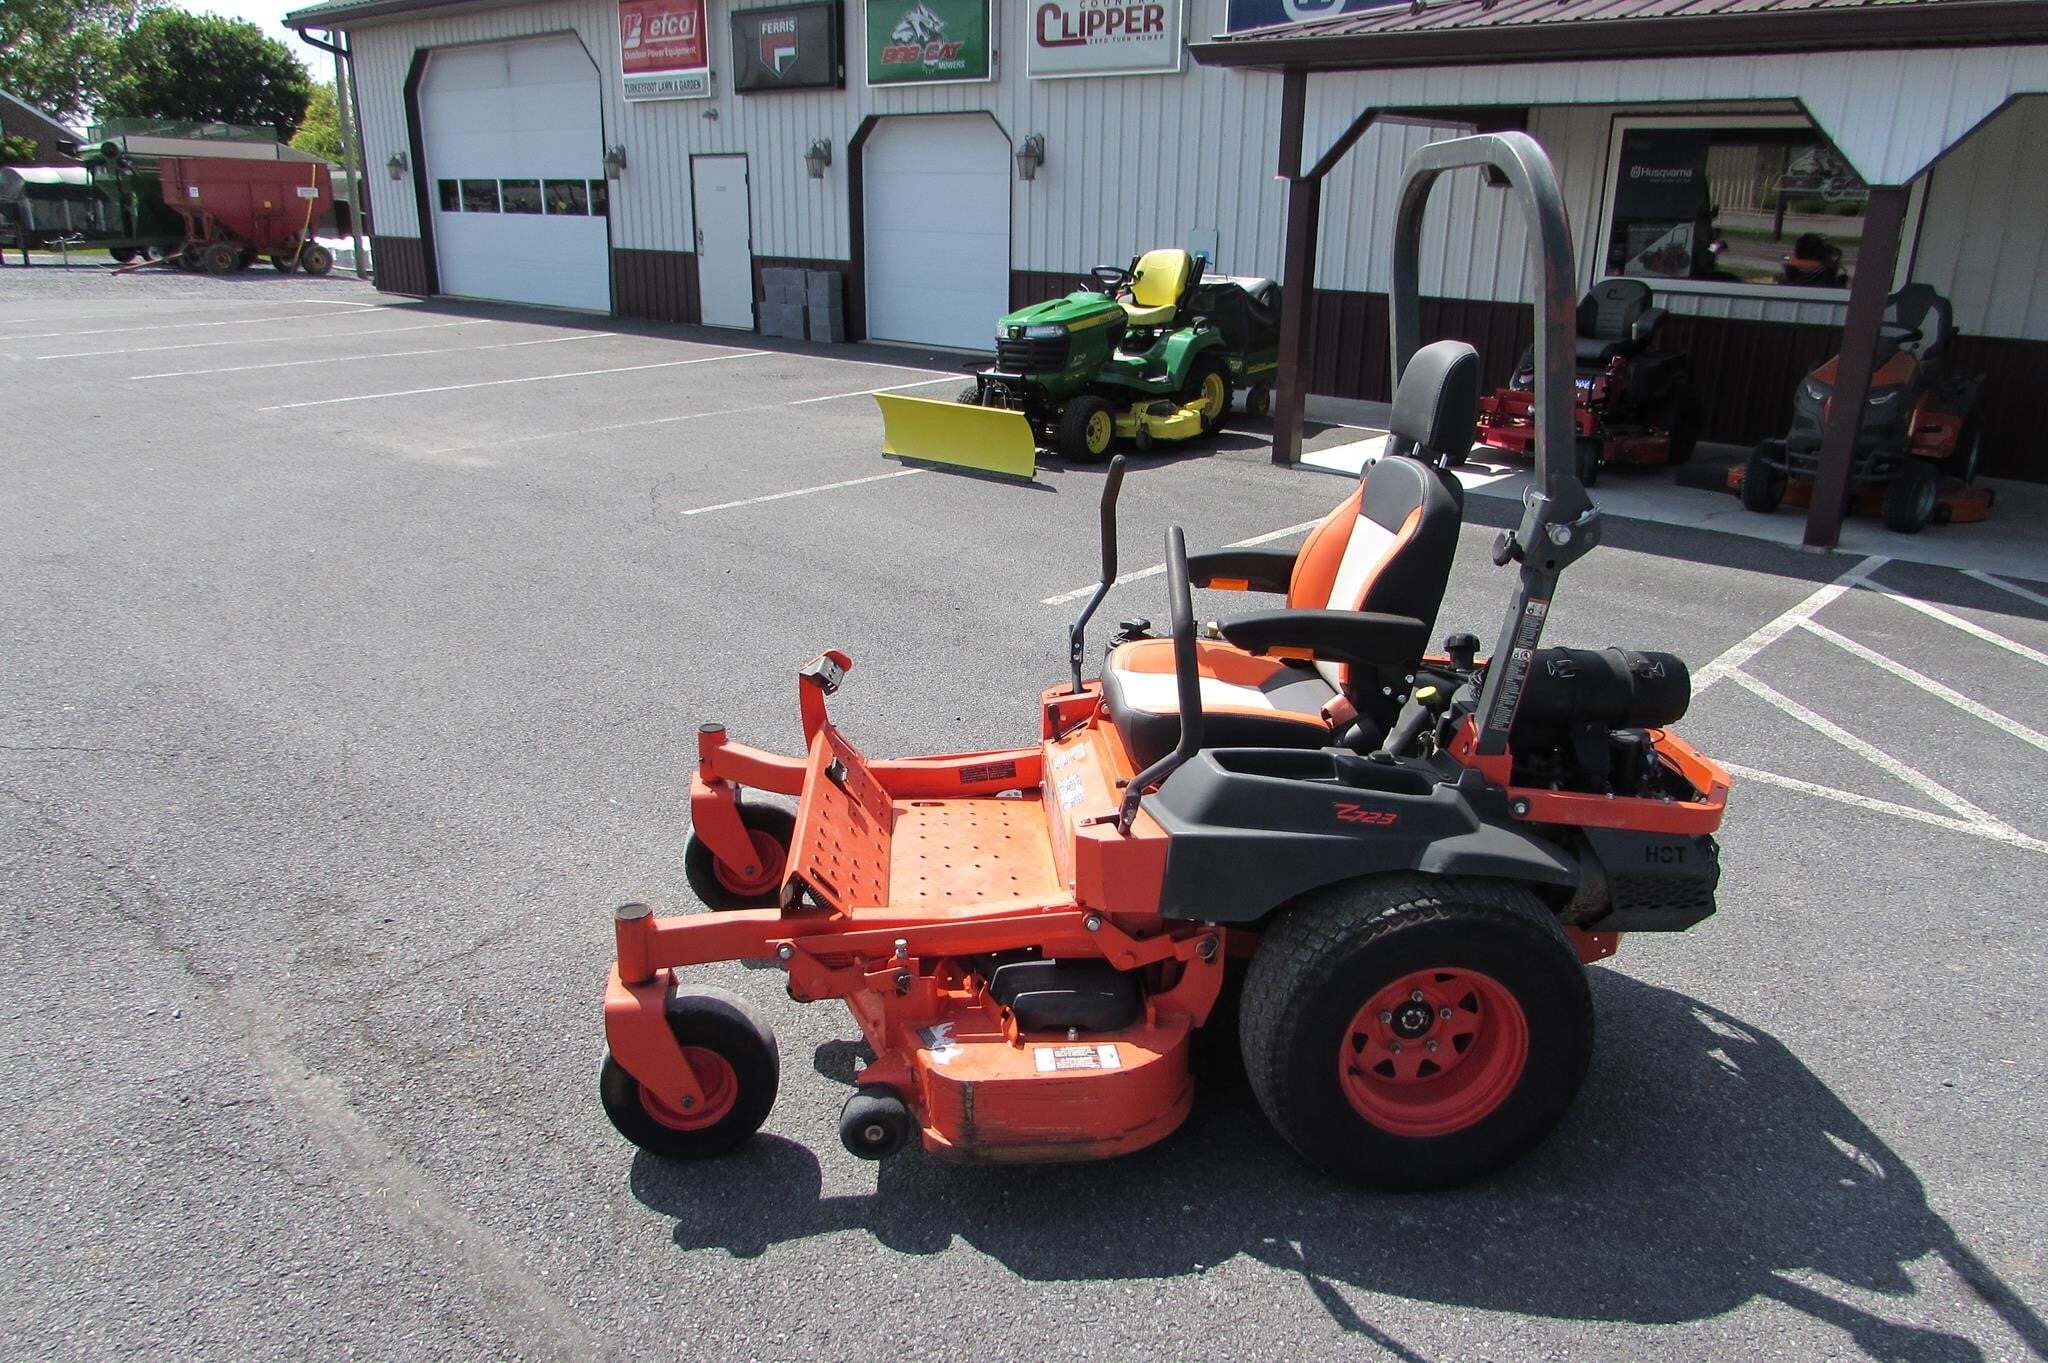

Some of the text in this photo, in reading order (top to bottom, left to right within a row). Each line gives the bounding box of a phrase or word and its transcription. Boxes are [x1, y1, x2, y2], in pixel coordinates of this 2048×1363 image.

[651, 11, 690, 36] efco
[761, 20, 795, 34] FERRIS
[1037, 3, 1164, 48] CLIPPER
[1135, 33, 1164, 41] MOWER
[679, 79, 702, 90] GARDEN
[1641, 167, 1692, 178] Husqvarna
[1332, 802, 1398, 824] Z723
[1646, 846, 1687, 864] HOT
